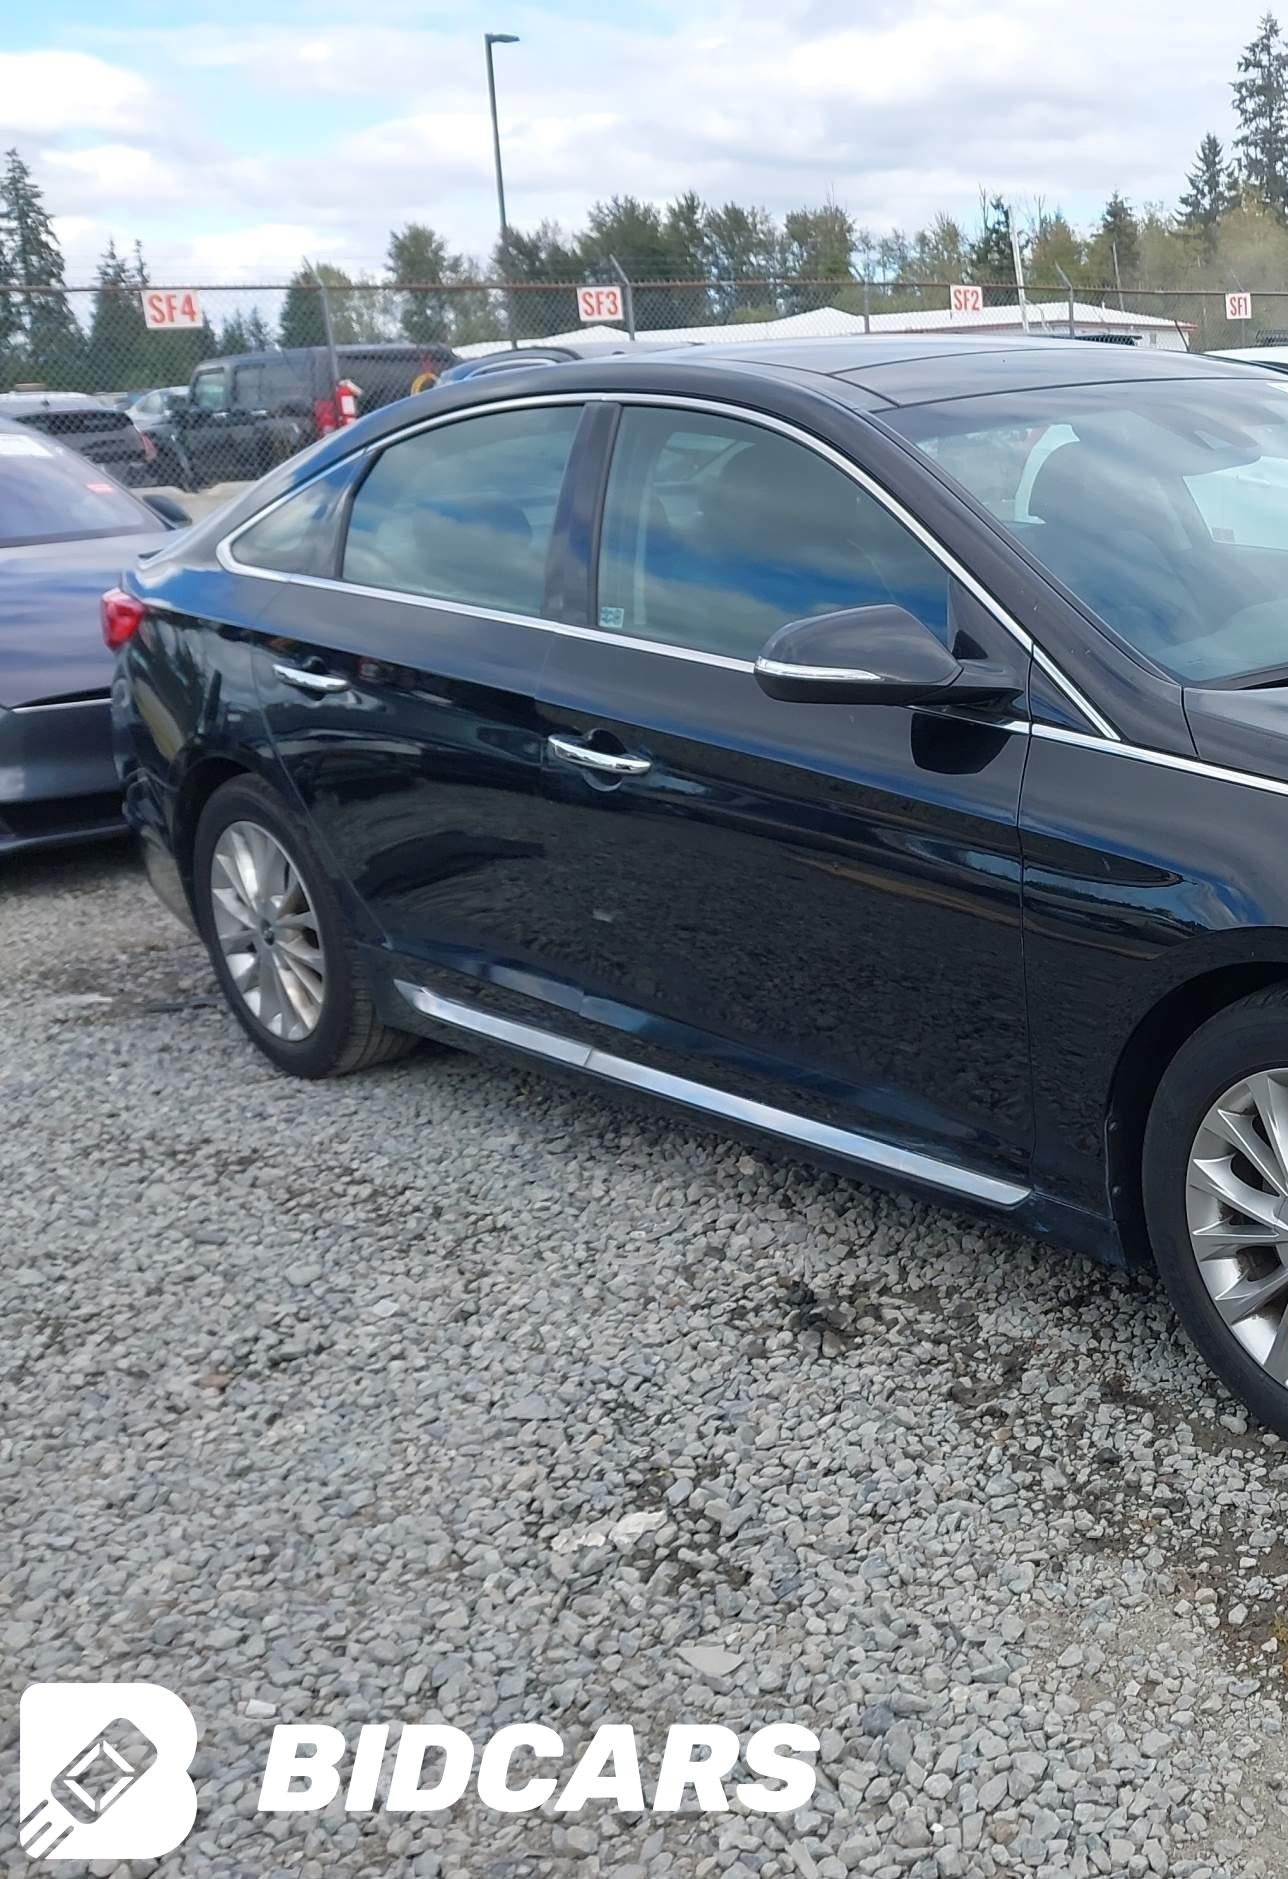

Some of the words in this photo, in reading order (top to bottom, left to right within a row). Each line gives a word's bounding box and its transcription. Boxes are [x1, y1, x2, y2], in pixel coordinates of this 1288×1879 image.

[148, 293, 197, 324] SF4
[582, 290, 619, 316] SF3
[953, 289, 980, 311] SF2
[1229, 296, 1248, 316] SF1
